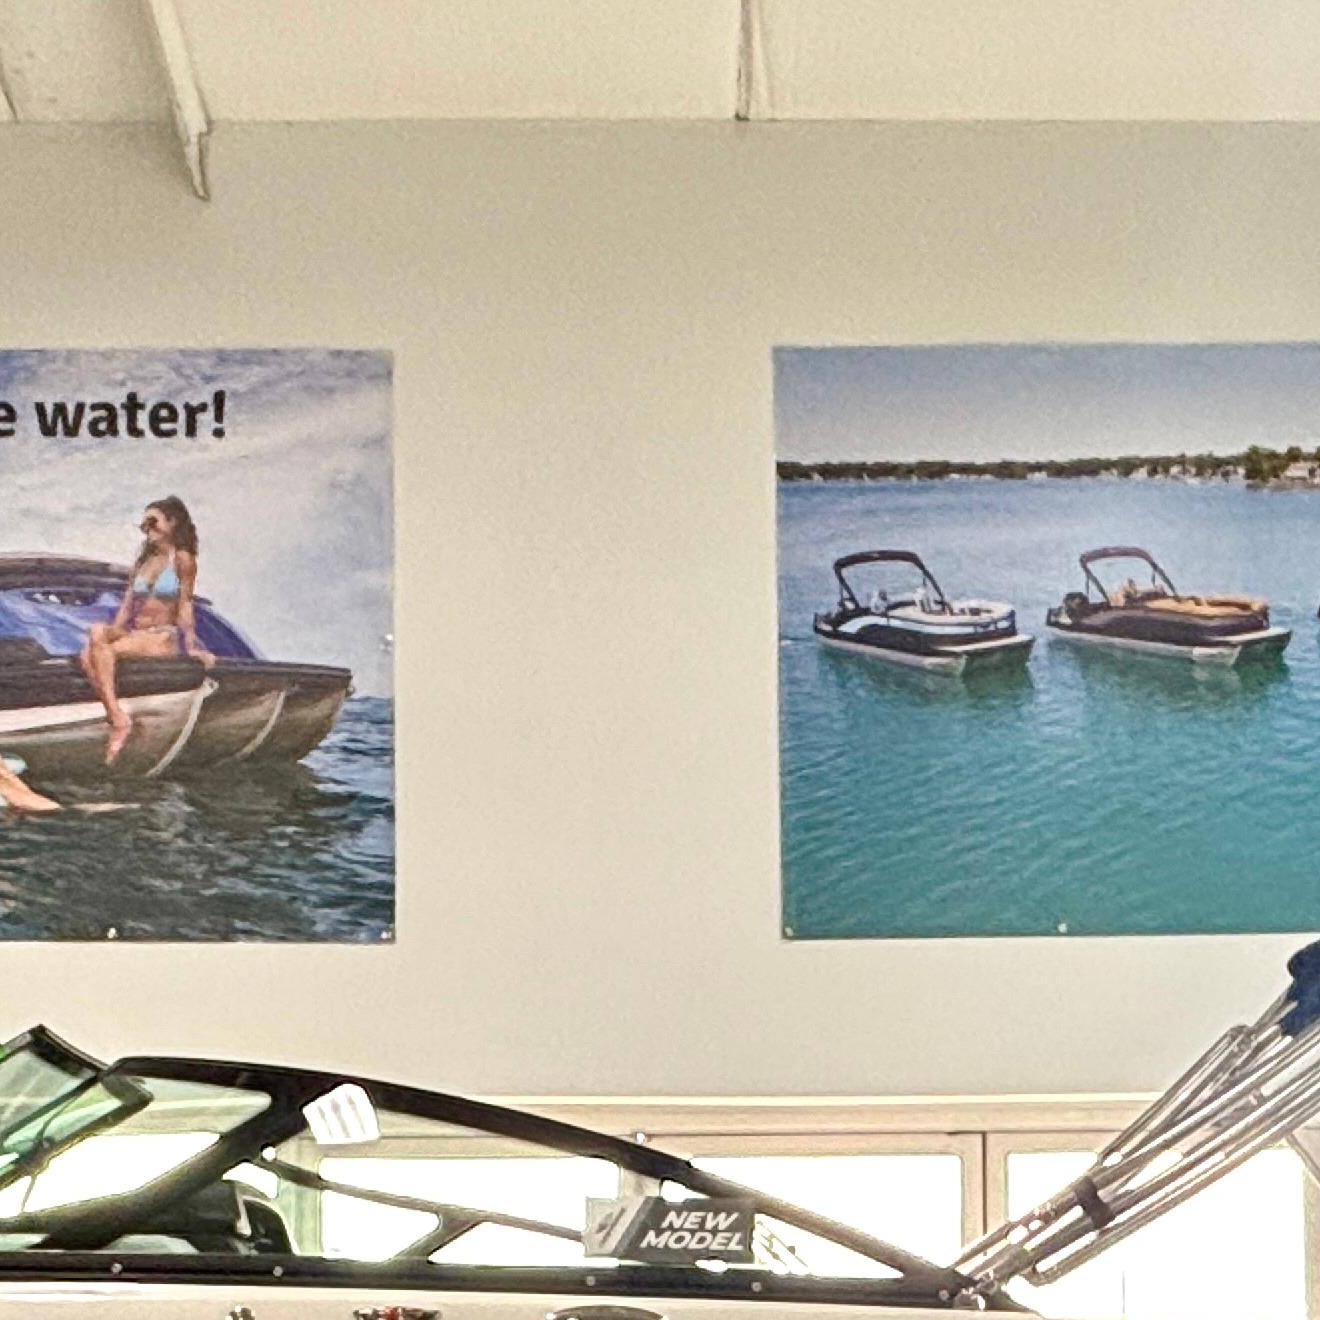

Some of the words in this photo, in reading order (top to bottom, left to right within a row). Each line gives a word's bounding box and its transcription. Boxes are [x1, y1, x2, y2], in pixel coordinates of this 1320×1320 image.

[33, 389, 227, 438] water!
[660, 1210, 740, 1230] NEW
[639, 1229, 745, 1251] MODEL
